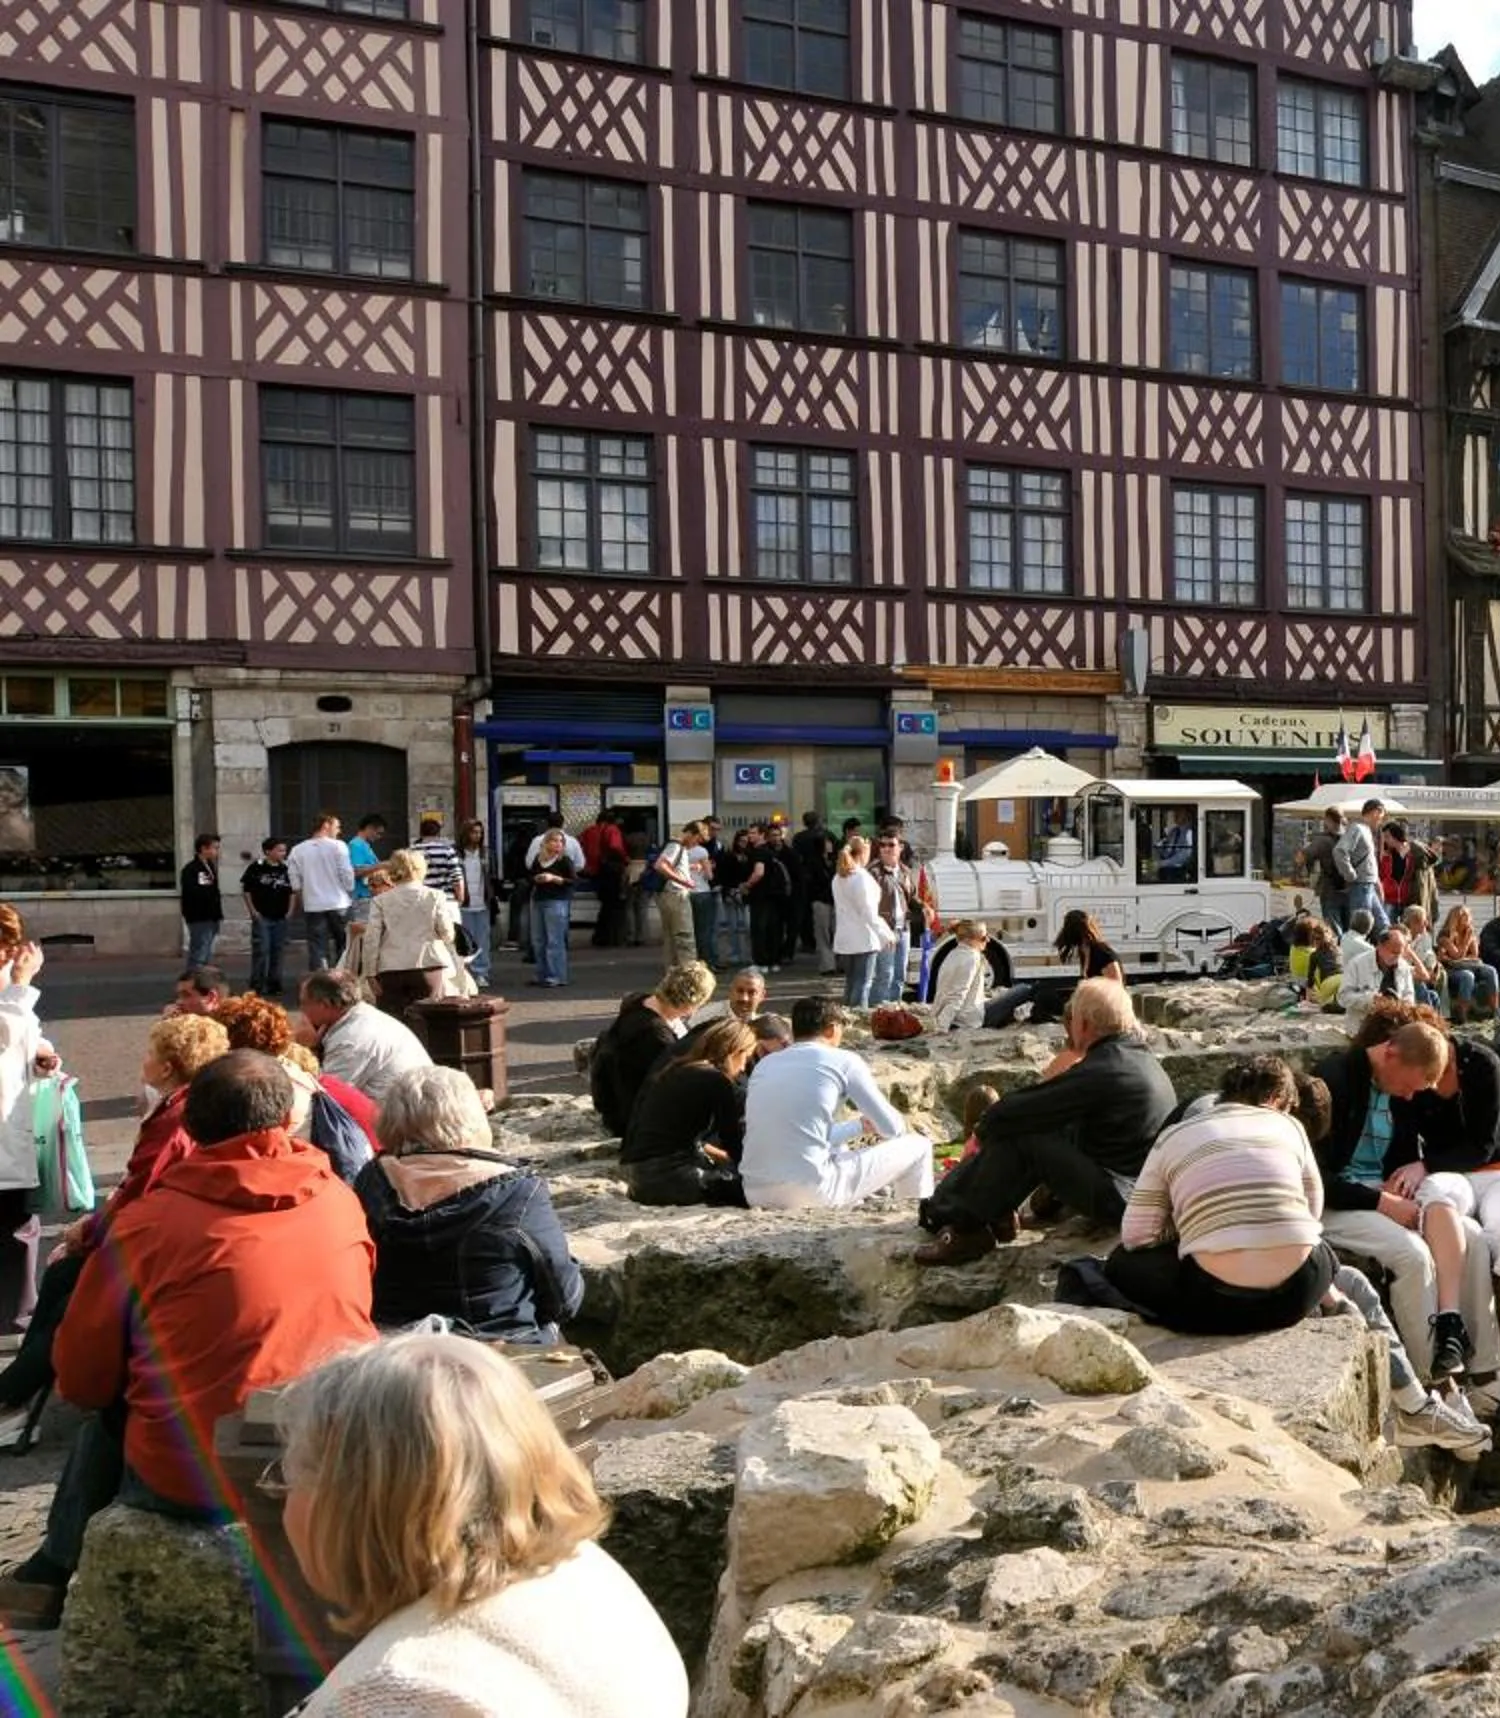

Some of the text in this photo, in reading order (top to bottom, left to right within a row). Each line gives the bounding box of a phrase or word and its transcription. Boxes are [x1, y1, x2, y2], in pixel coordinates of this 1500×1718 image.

[670, 711, 710, 728] CIC
[900, 716, 933, 731] CIC
[1239, 713, 1306, 727] Cadeaux
[738, 767, 773, 781] CIC
